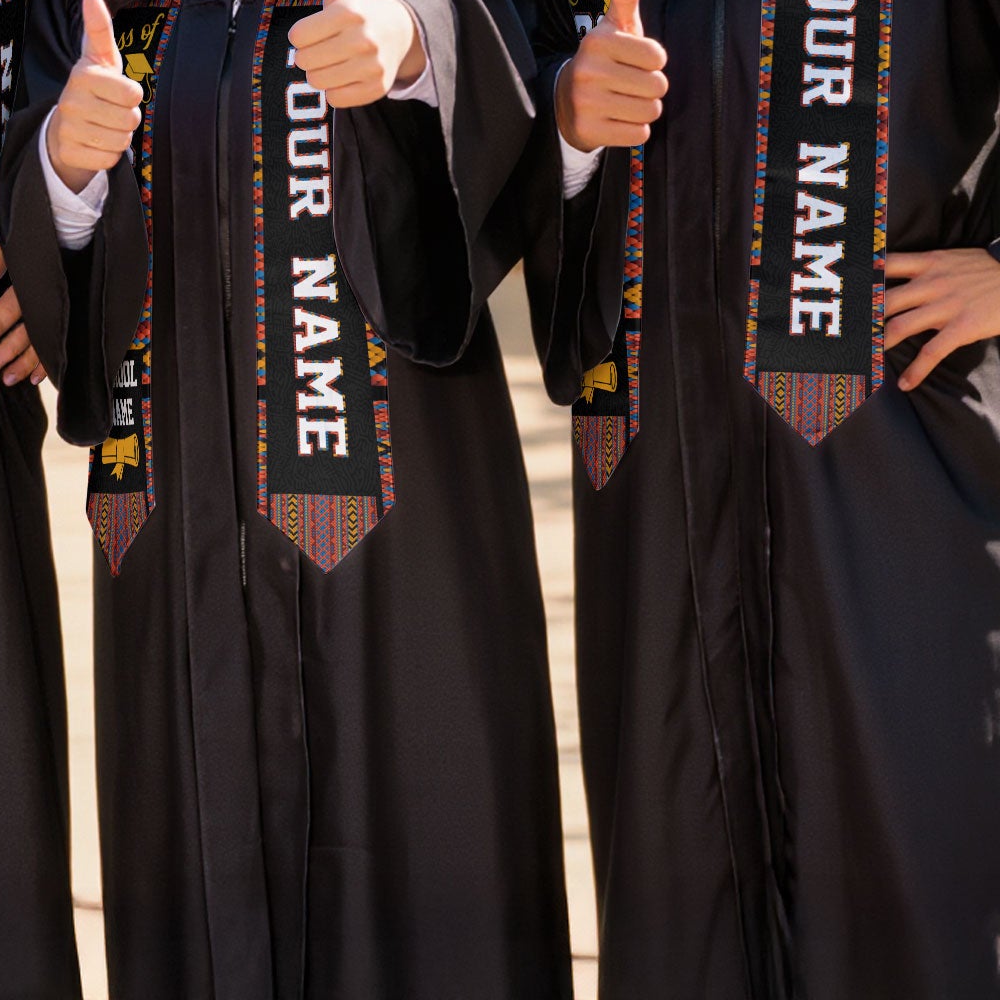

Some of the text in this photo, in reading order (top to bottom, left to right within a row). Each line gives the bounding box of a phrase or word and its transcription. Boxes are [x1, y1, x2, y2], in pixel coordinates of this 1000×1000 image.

[140, 12, 165, 50] of
[285, 46, 349, 458] OUR NAME
[789, 141, 850, 338] NAME
